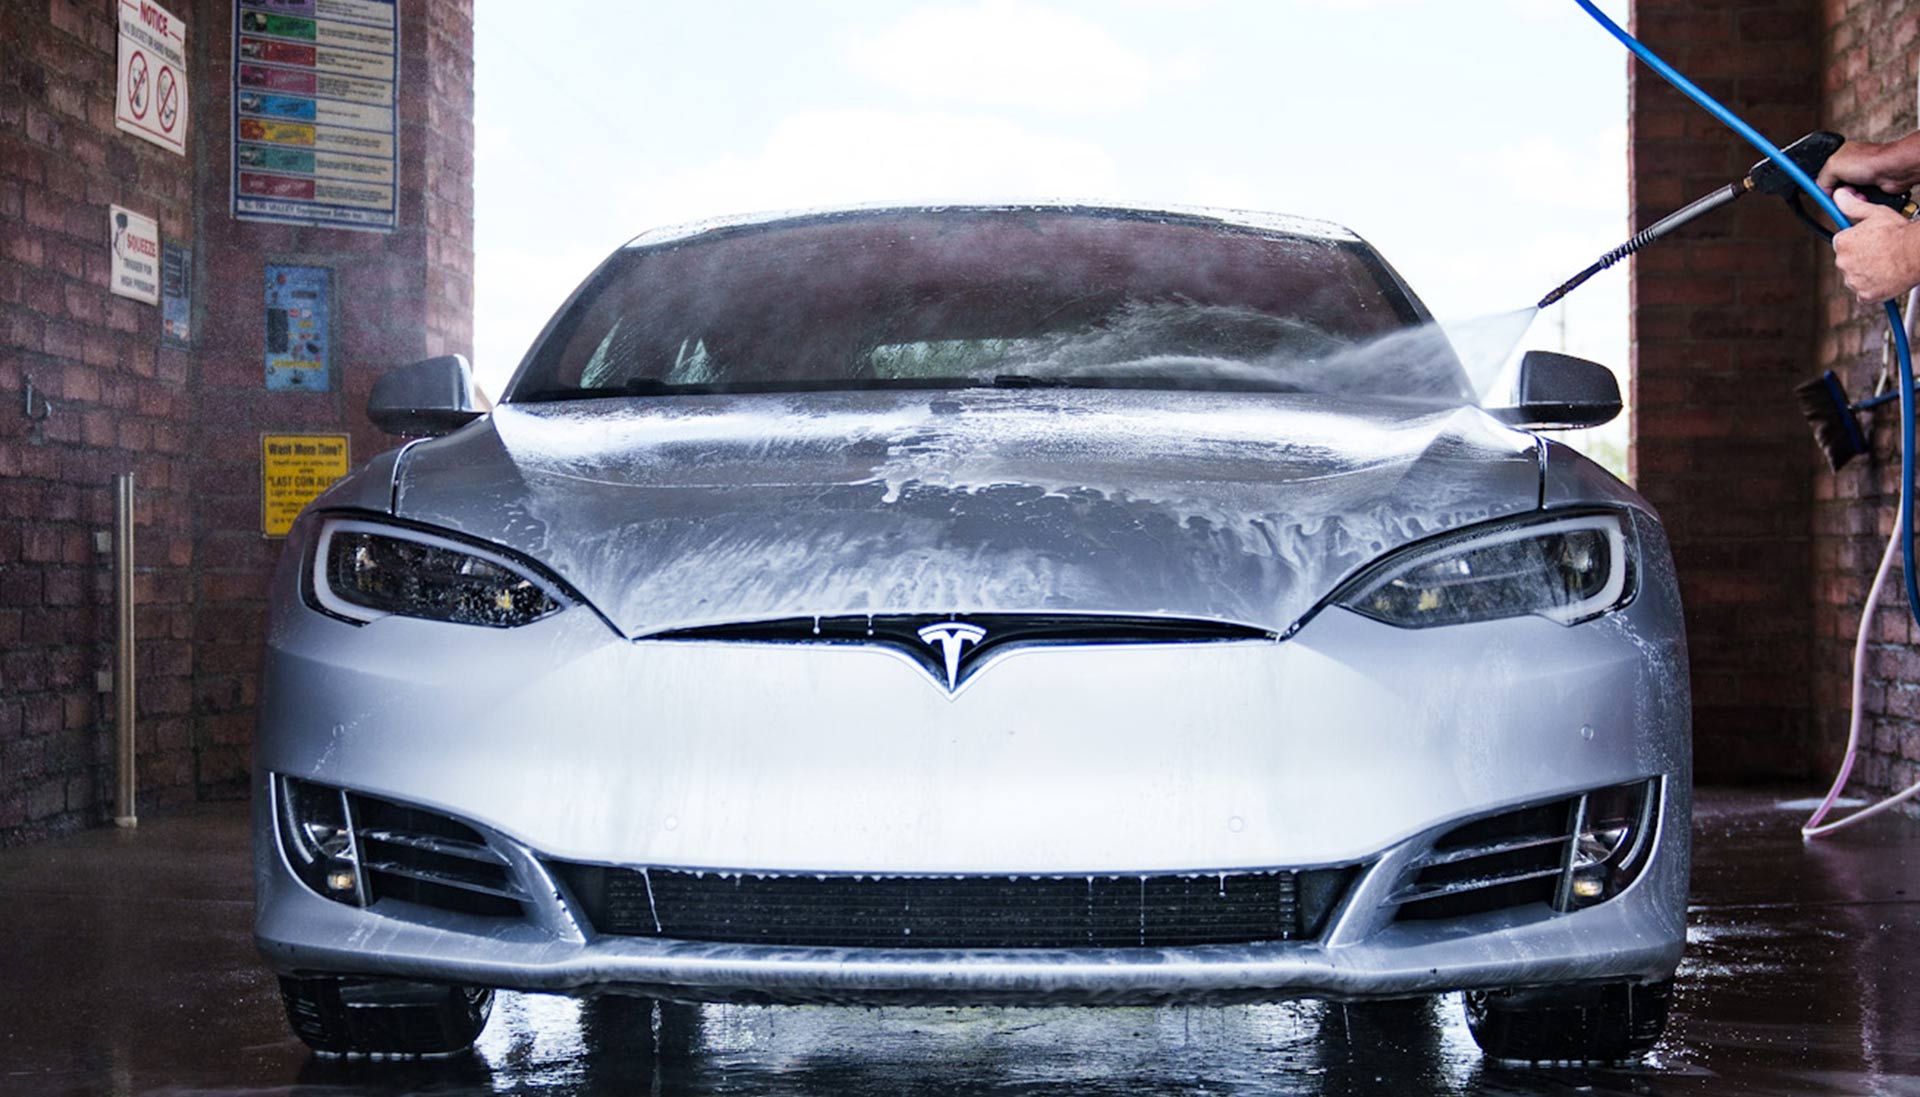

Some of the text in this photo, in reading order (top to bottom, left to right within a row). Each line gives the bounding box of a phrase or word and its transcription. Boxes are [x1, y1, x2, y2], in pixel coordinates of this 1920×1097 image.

[141, 2, 168, 38] NOTICE
[269, 203, 294, 213] VALLEY
[295, 206, 332, 216] Equipment
[127, 234, 156, 258] SQUEEZE
[269, 443, 342, 455] Want More Time?
[294, 476, 315, 487] COIN
